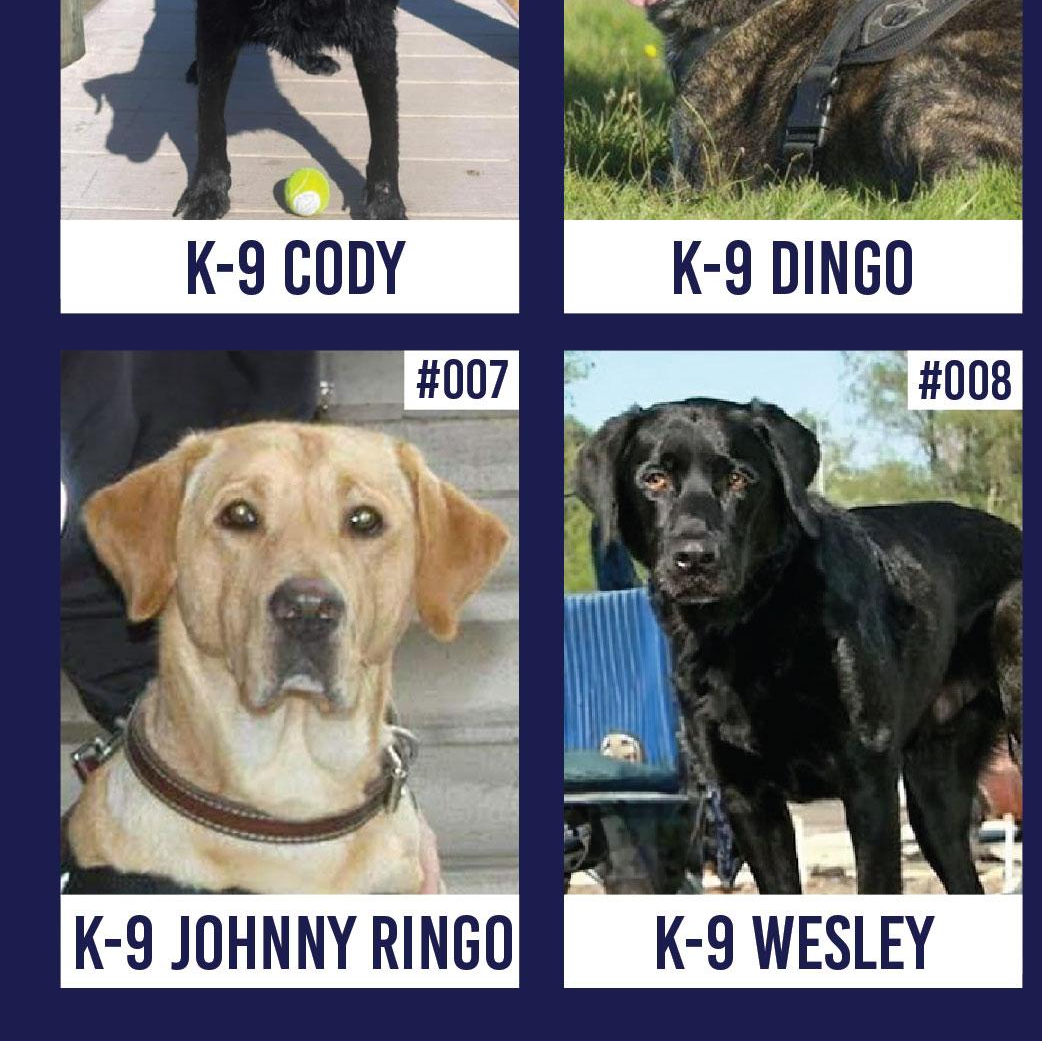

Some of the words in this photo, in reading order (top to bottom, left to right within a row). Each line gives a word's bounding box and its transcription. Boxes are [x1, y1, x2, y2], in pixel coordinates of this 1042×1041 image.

[188, 240, 264, 295] K-9
[285, 240, 406, 295] CODY
[674, 240, 751, 295] K-9
[773, 240, 912, 295] DINGO
[417, 359, 508, 399] #007
[919, 360, 1012, 400] #008
[76, 915, 152, 970] K-9
[172, 915, 357, 970] JOHNNY
[373, 915, 513, 970] RINGO
[657, 915, 733, 970] K-9
[752, 915, 935, 970] WESLEY
